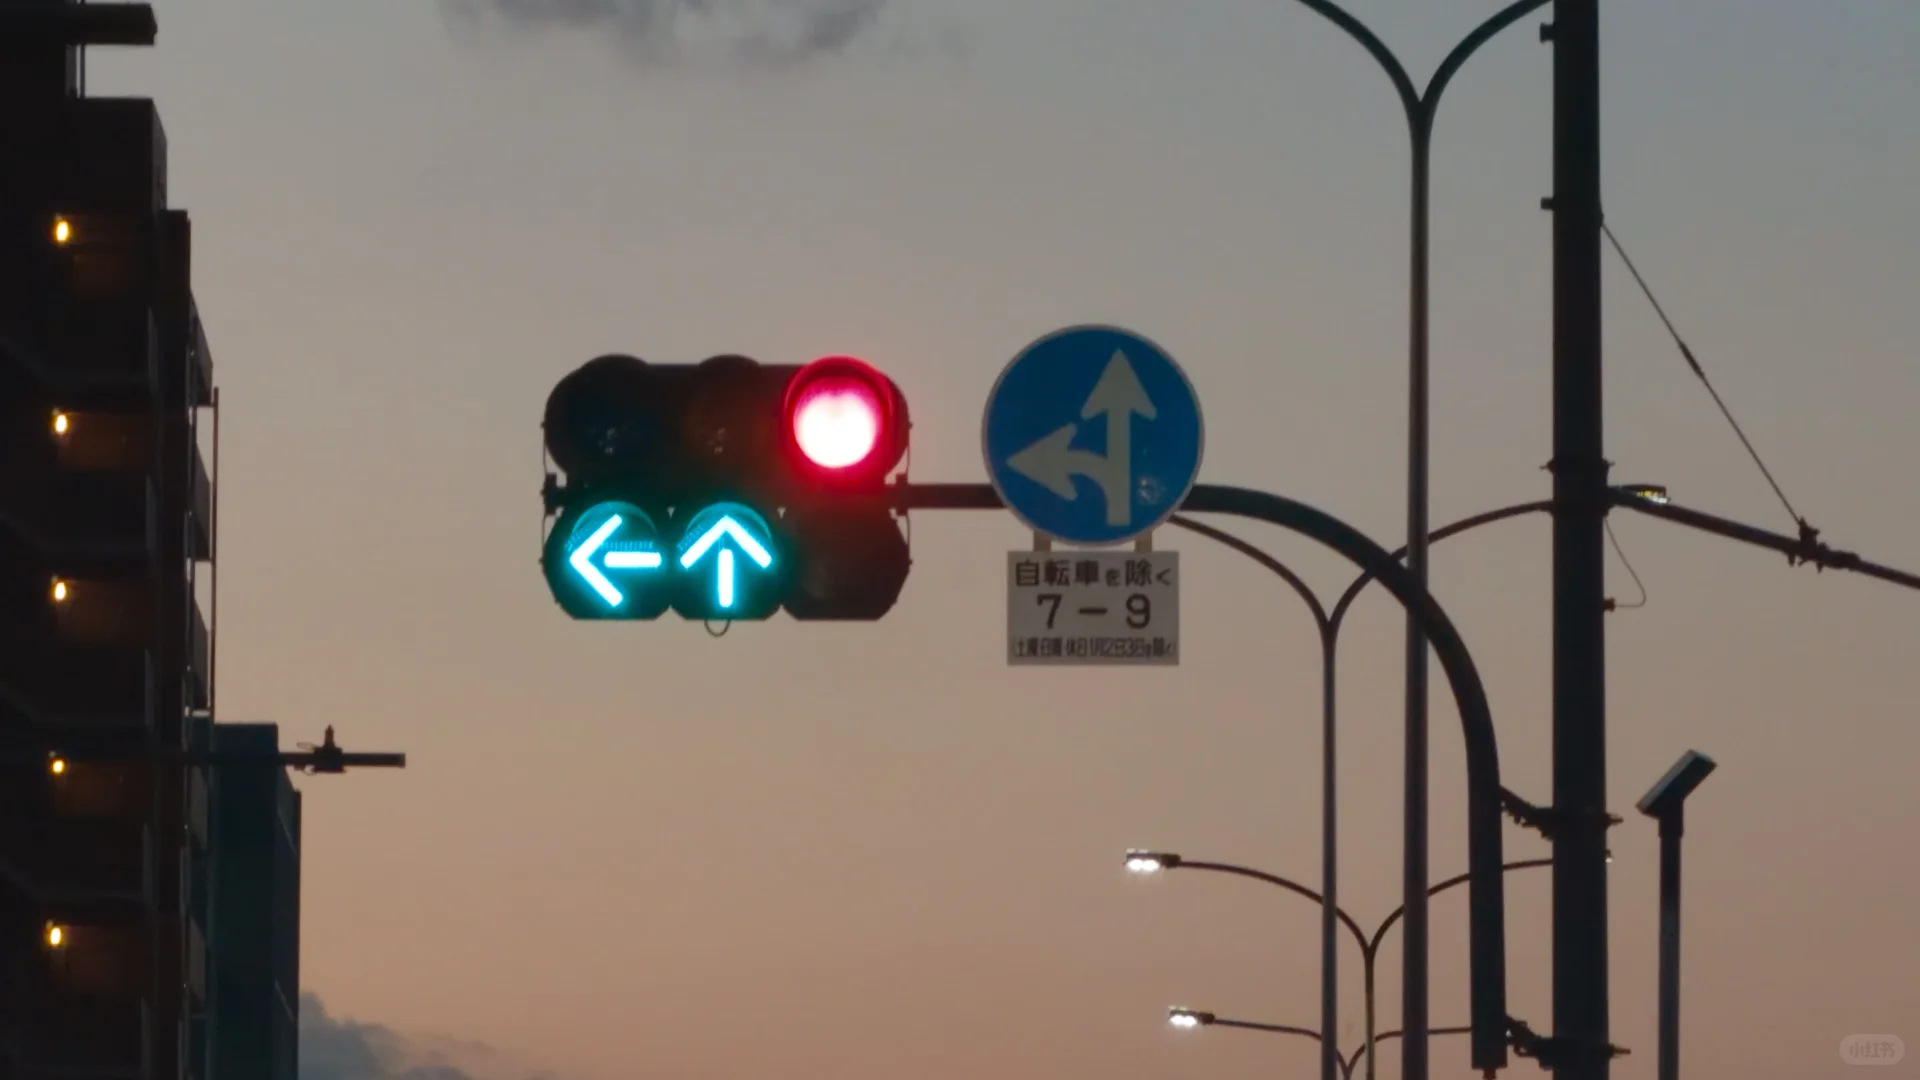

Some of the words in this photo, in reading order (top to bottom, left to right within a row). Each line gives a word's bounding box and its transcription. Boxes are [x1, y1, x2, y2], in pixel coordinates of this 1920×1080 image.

[1016, 558, 1171, 587] 自転車を除く
